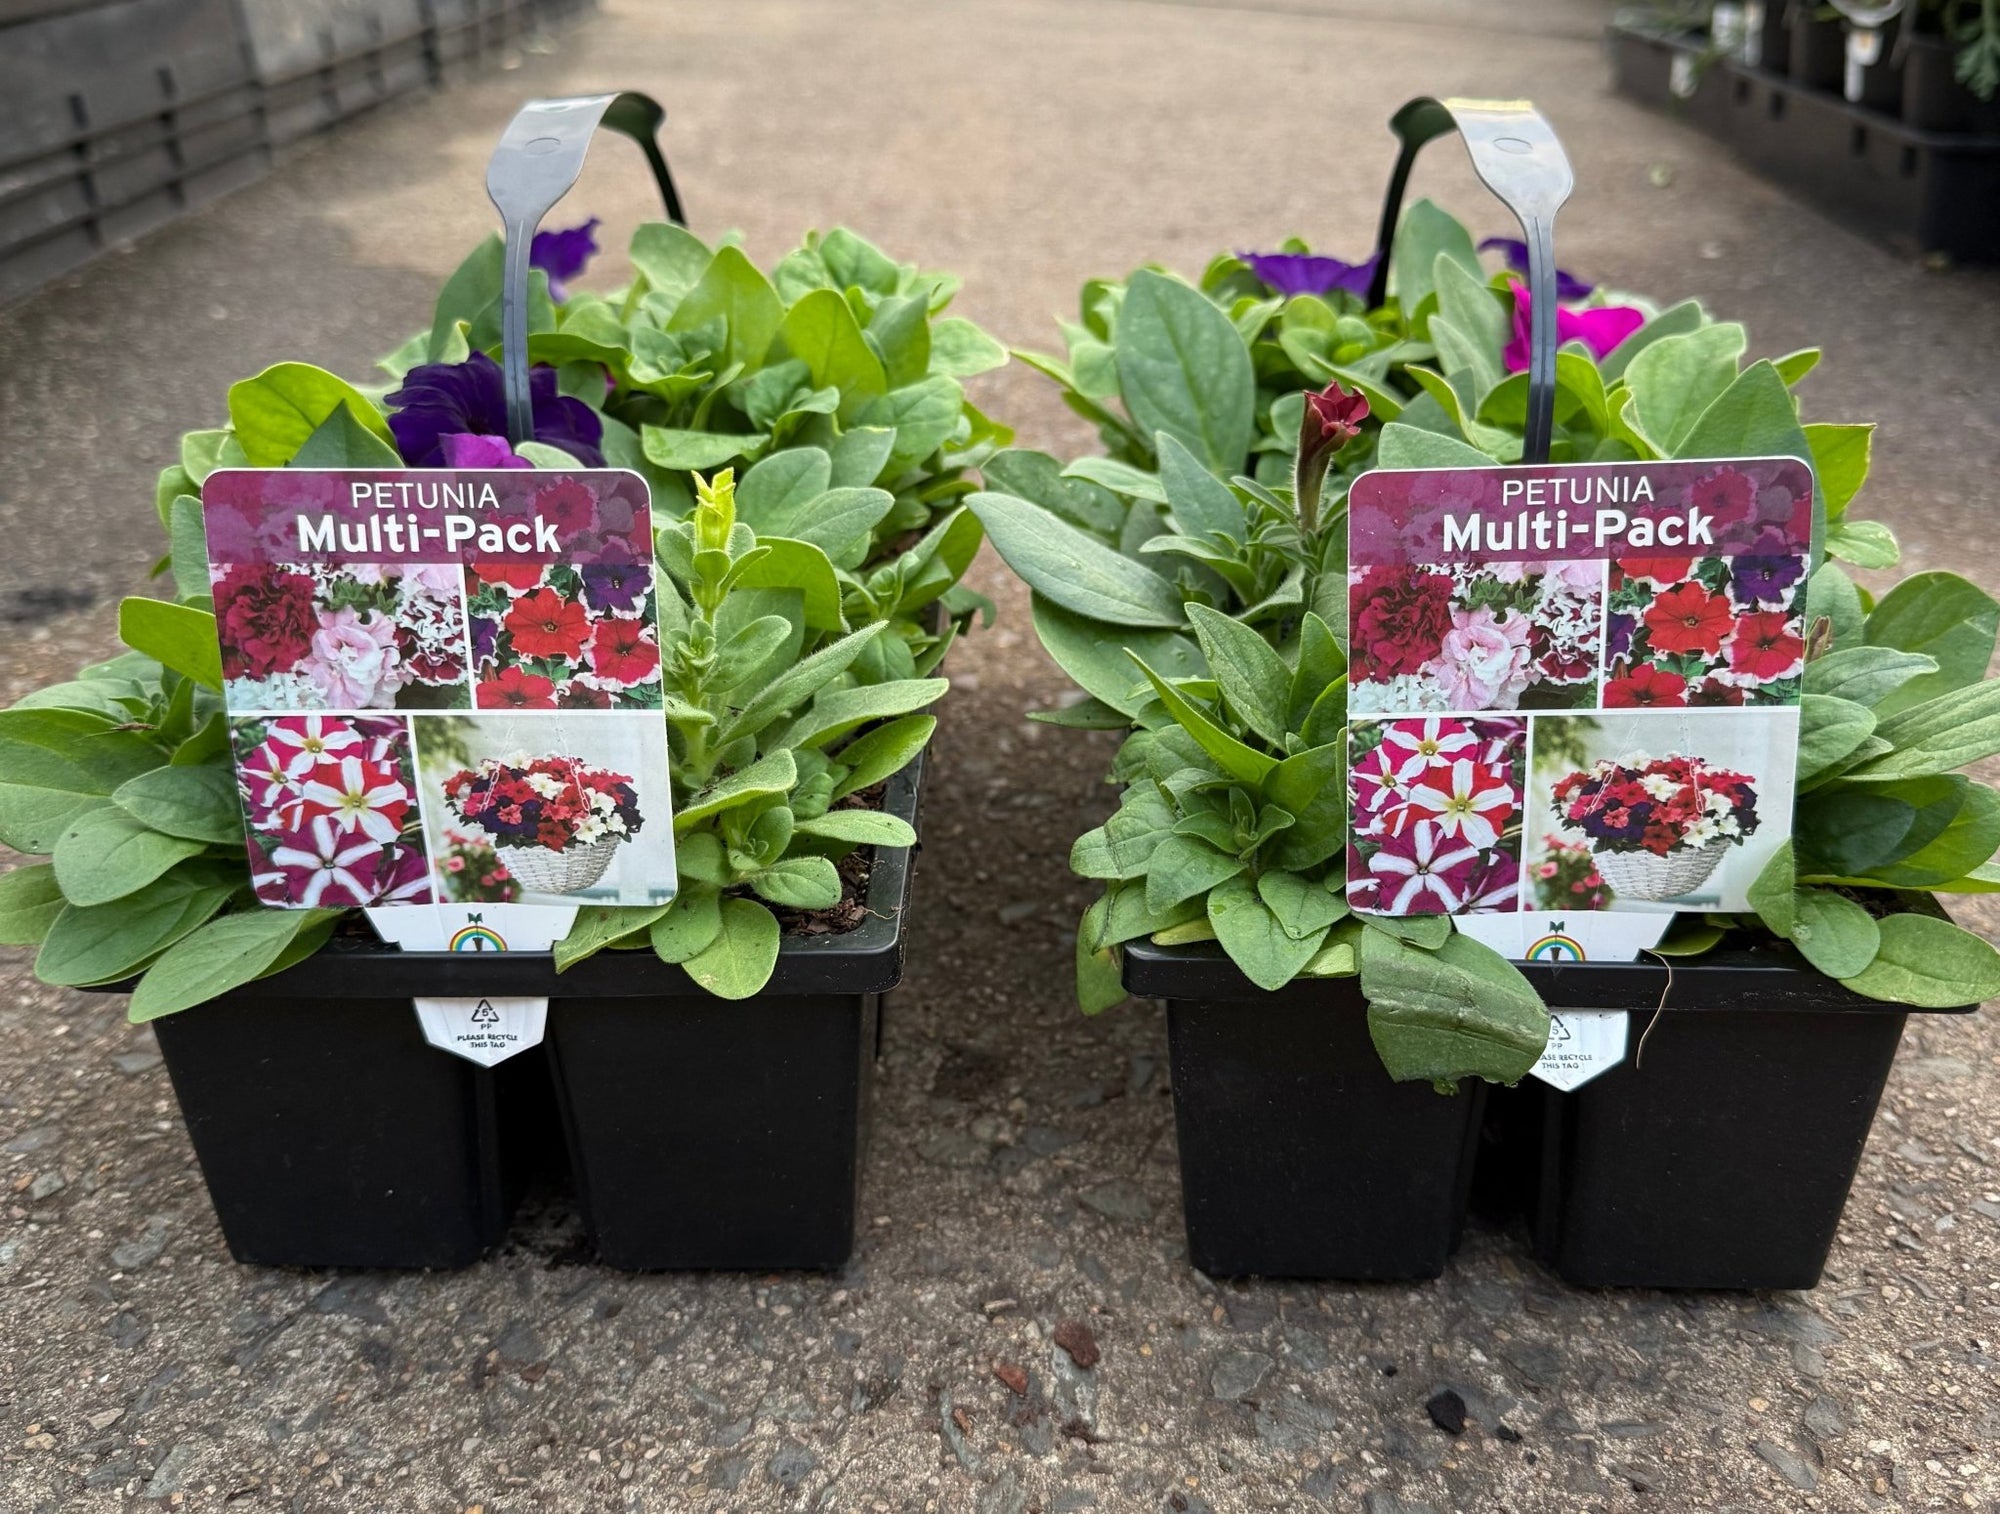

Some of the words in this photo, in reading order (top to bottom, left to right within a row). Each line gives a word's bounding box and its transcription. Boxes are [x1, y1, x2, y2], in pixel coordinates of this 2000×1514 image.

[351, 482, 500, 509] PETUNIA
[1502, 475, 1655, 506] PETUNIA
[297, 513, 562, 553] Multi-Pack
[1443, 506, 1714, 552] Multi-Pack
[481, 1008, 489, 1017] 5
[487, 1033, 518, 1041] RECYCLE
[1552, 1025, 1559, 1035] 5
